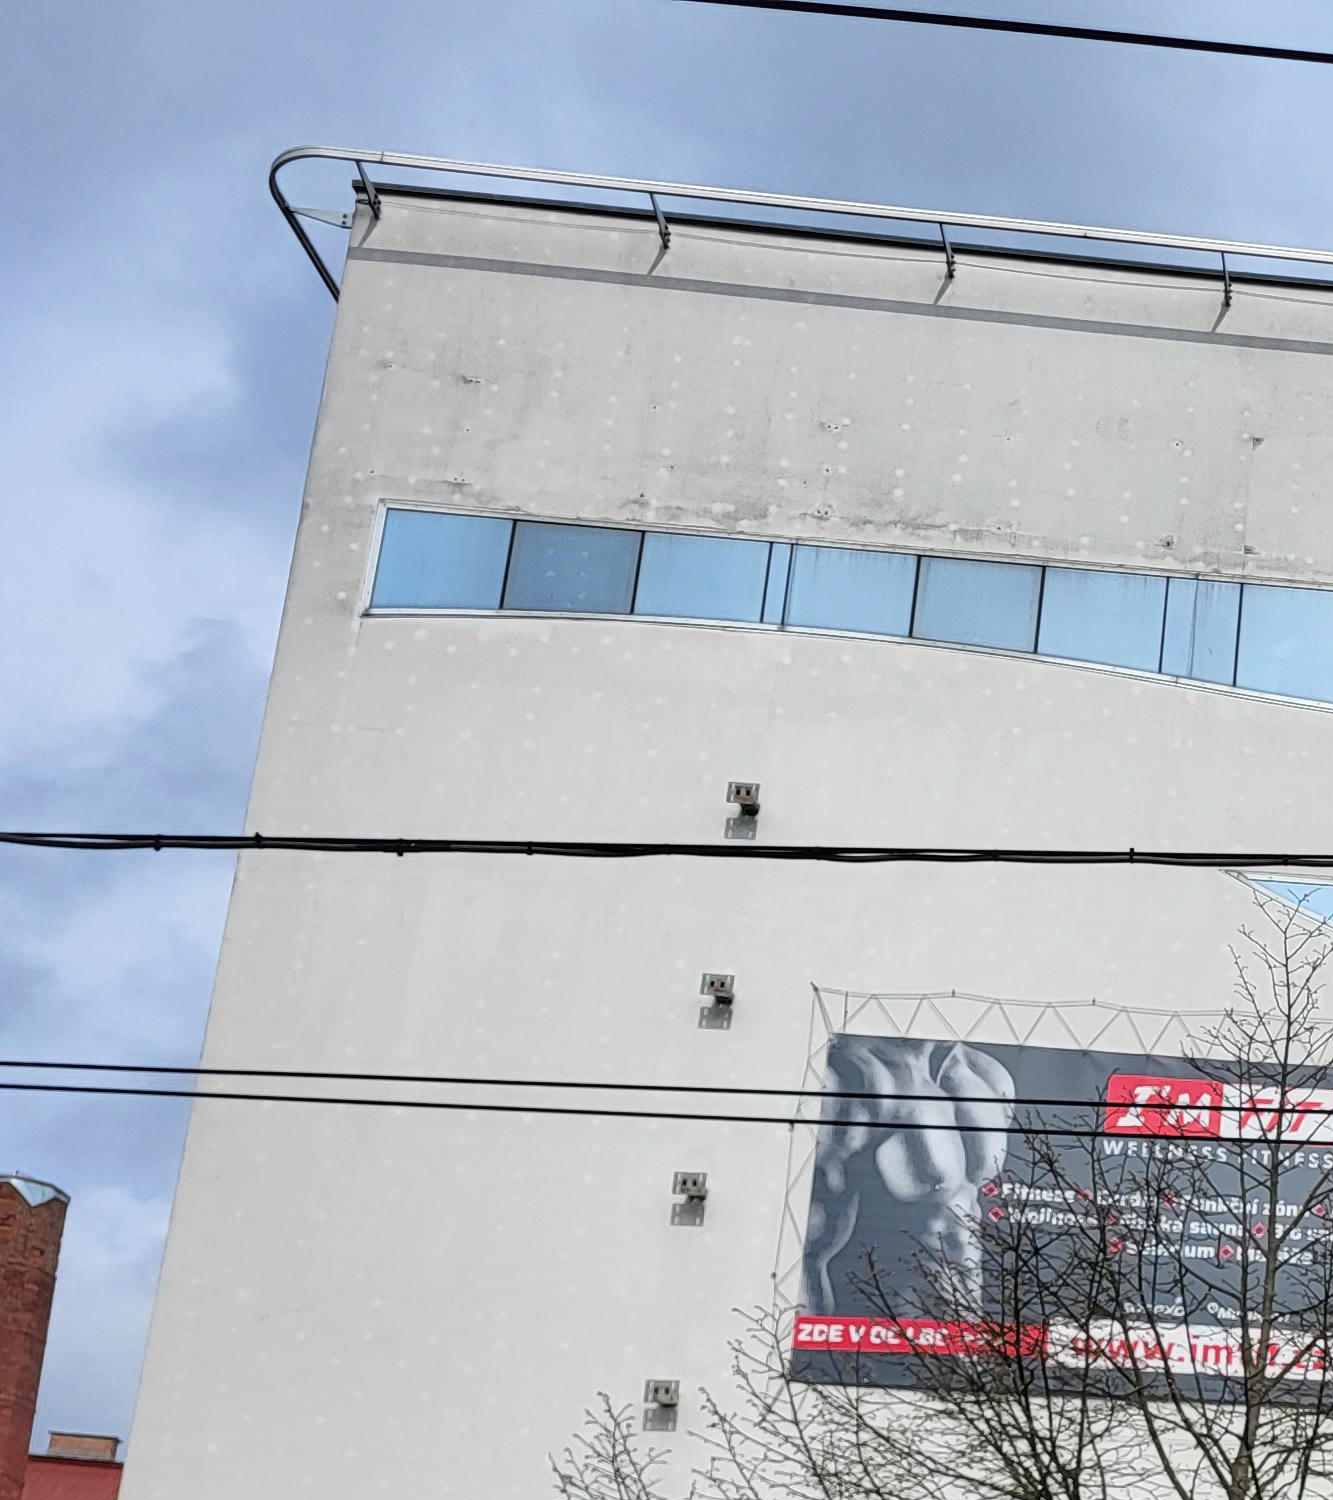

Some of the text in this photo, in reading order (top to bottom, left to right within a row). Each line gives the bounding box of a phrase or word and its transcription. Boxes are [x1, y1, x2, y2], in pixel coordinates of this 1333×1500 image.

[1116, 1085, 1213, 1128] I'M
[1103, 1138, 1227, 1162] WELLNESS
[797, 1323, 844, 1343] ZDE
[849, 1324, 866, 1343] V
